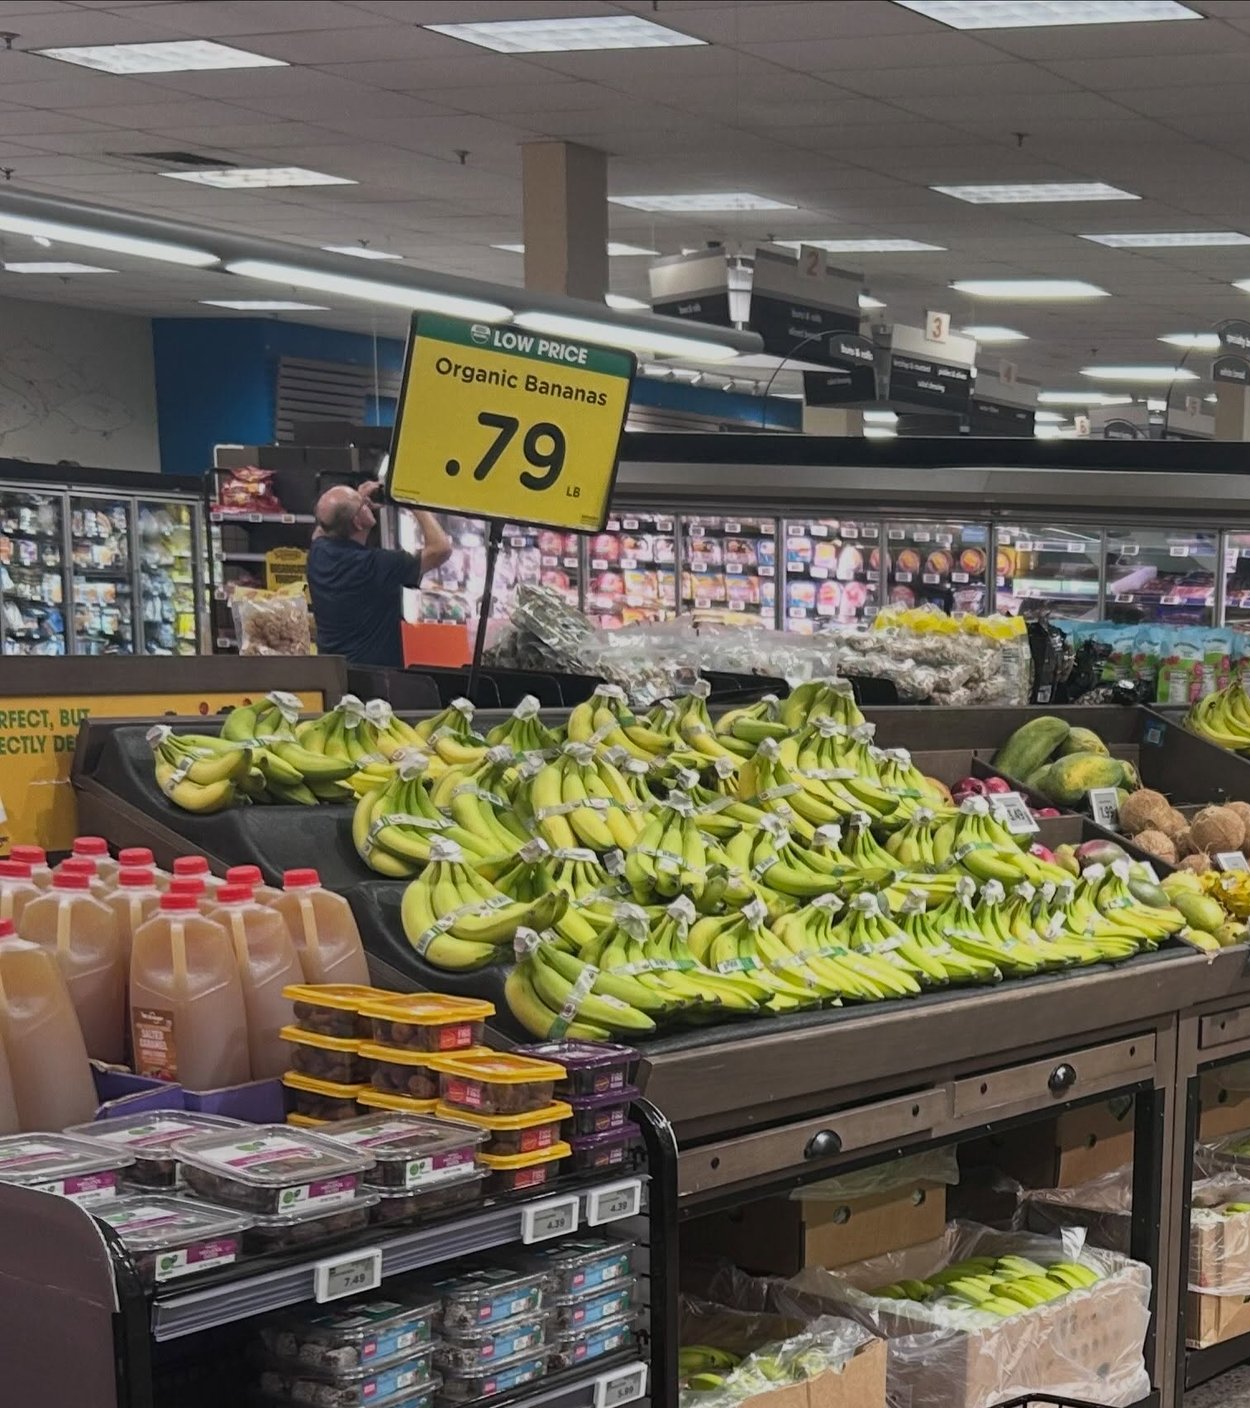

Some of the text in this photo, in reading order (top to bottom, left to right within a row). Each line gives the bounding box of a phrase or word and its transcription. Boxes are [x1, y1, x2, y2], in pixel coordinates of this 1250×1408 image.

[932, 316, 943, 339] 3
[493, 330, 589, 364] LOW PRICE
[435, 357, 608, 407] Organic Bananas
[445, 411, 566, 491] .79
[565, 486, 581, 498] LB
[0, 709, 54, 731] RFECT,
[0, 733, 76, 755] ECTLY DE
[344, 1273, 366, 1287] 7.49
